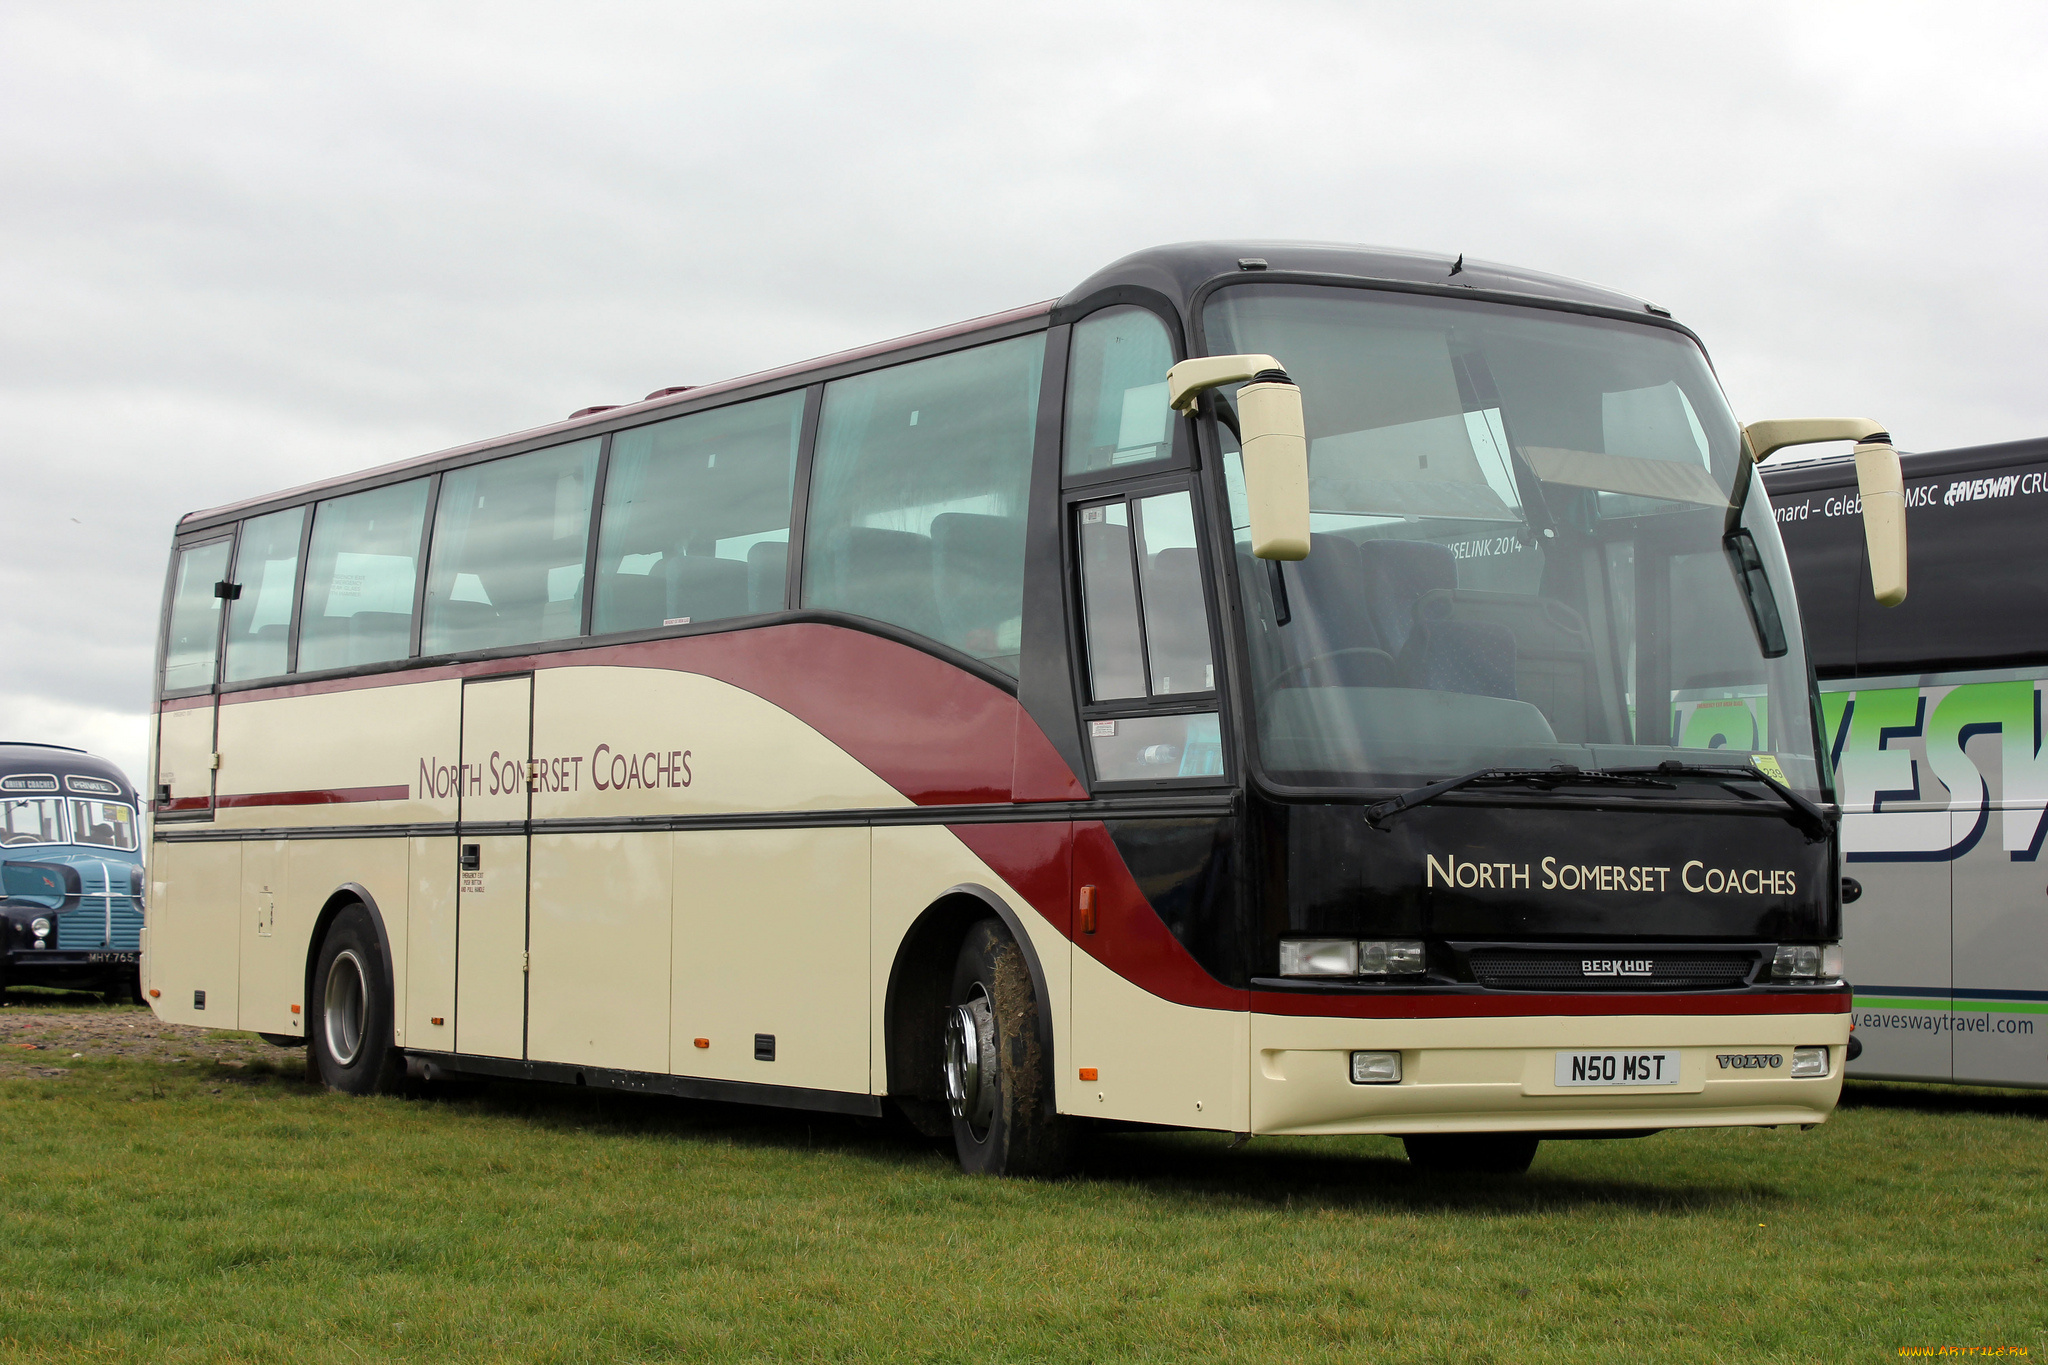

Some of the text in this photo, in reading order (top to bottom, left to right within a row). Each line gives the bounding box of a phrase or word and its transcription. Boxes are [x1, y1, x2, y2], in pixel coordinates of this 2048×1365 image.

[1824, 493, 1863, 517] Celeb
[1904, 485, 1938, 507] MSC
[1944, 475, 2020, 506] EAVESWAY
[1448, 539, 1493, 560] SELINK
[1494, 536, 1522, 555] 2014
[419, 757, 482, 800] NORTH
[592, 743, 692, 791] COACHES
[5, 781, 55, 789] ORIENT COACHES
[73, 781, 109, 791] PRIVATE
[1427, 854, 1796, 895] NORTH SOMERSET COACHES
[89, 953, 134, 962] MHY 765
[1582, 960, 1653, 976] BERKHOF
[1572, 1055, 1666, 1081] N50 MST
[1716, 1054, 1783, 1069] VOLVO
